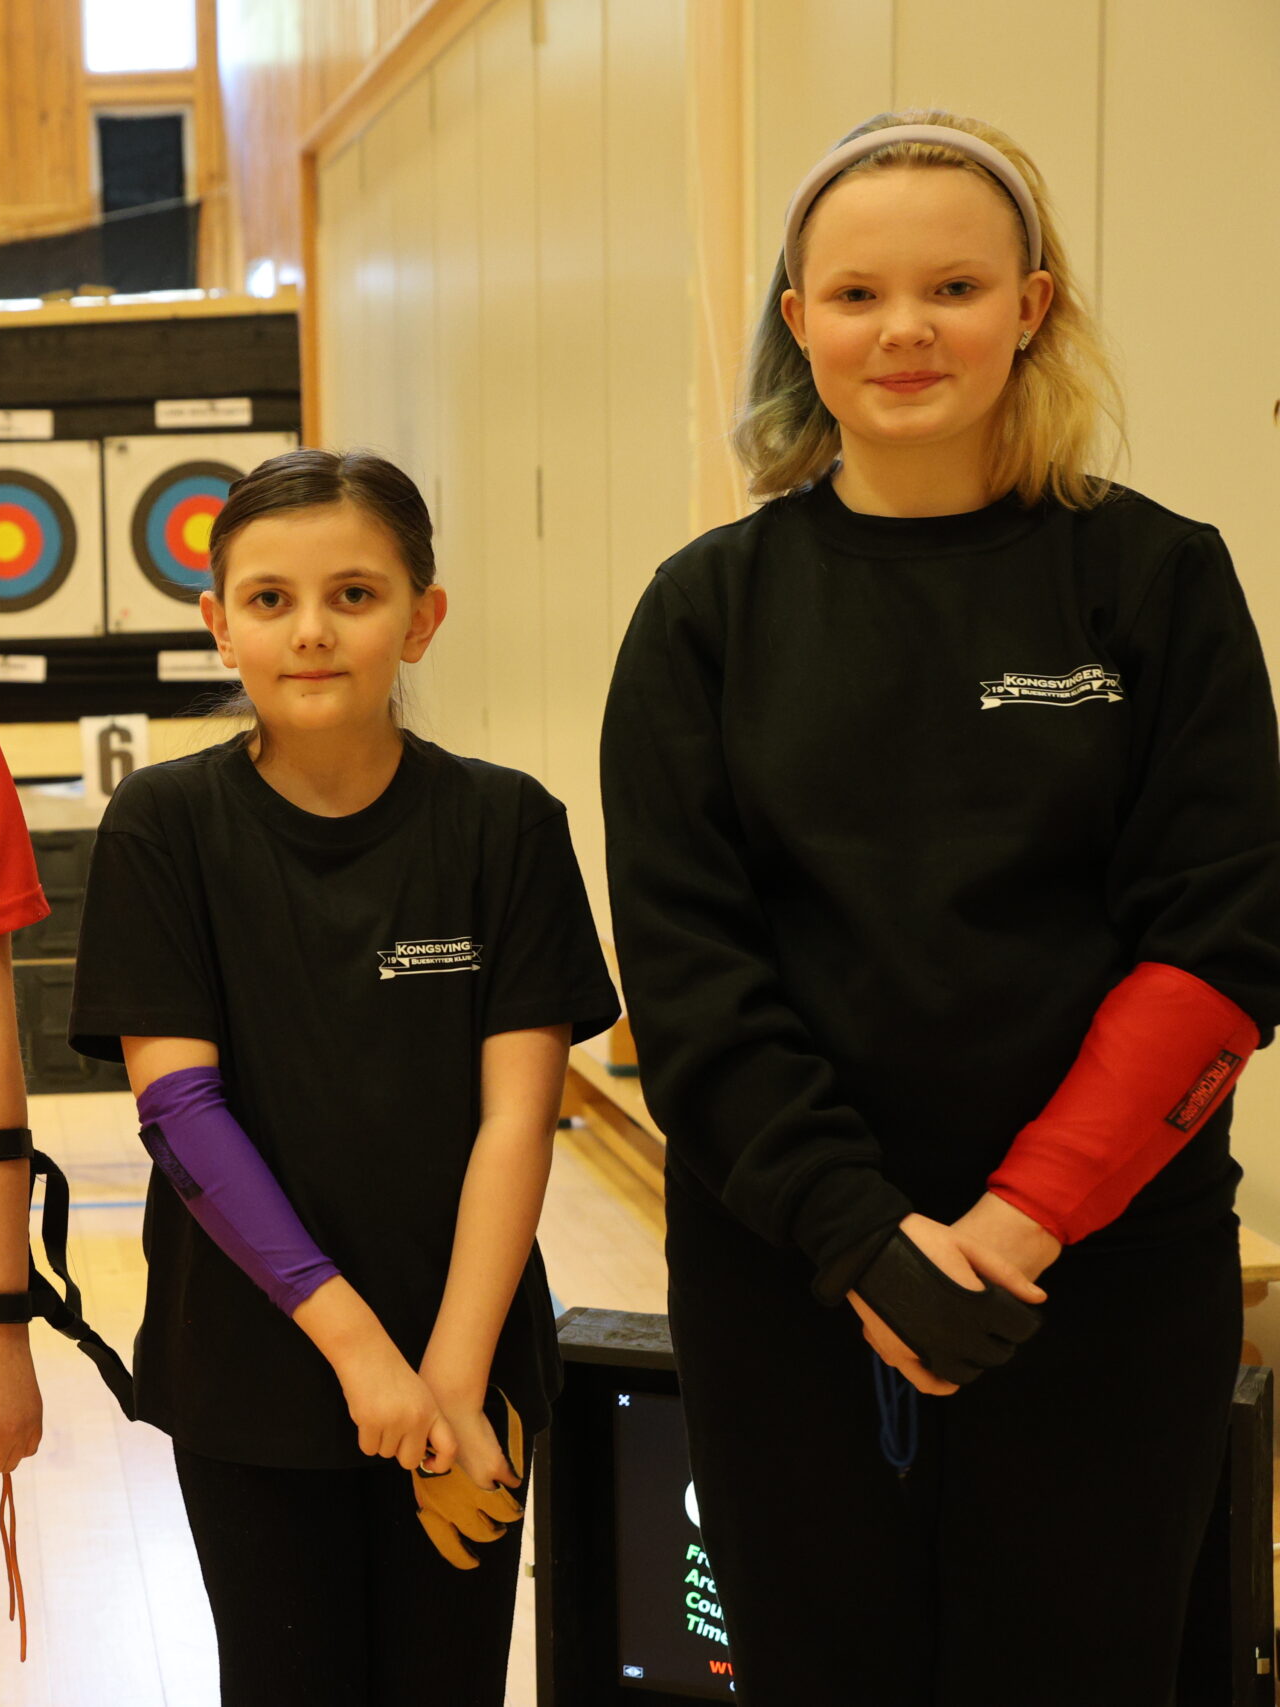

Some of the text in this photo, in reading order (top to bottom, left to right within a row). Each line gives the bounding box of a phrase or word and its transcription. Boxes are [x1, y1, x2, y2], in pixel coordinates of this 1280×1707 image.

[991, 686, 1004, 694] 19
[1006, 668, 1103, 689] KONGSVINGER
[1106, 678, 1116, 687] 70
[99, 724, 134, 797] 6
[397, 941, 471, 955] KONGSVING
[686, 1544, 710, 1568] Fr
[684, 1568, 717, 1594] Arc
[686, 1591, 724, 1620] Cou
[686, 1613, 729, 1646] Time
